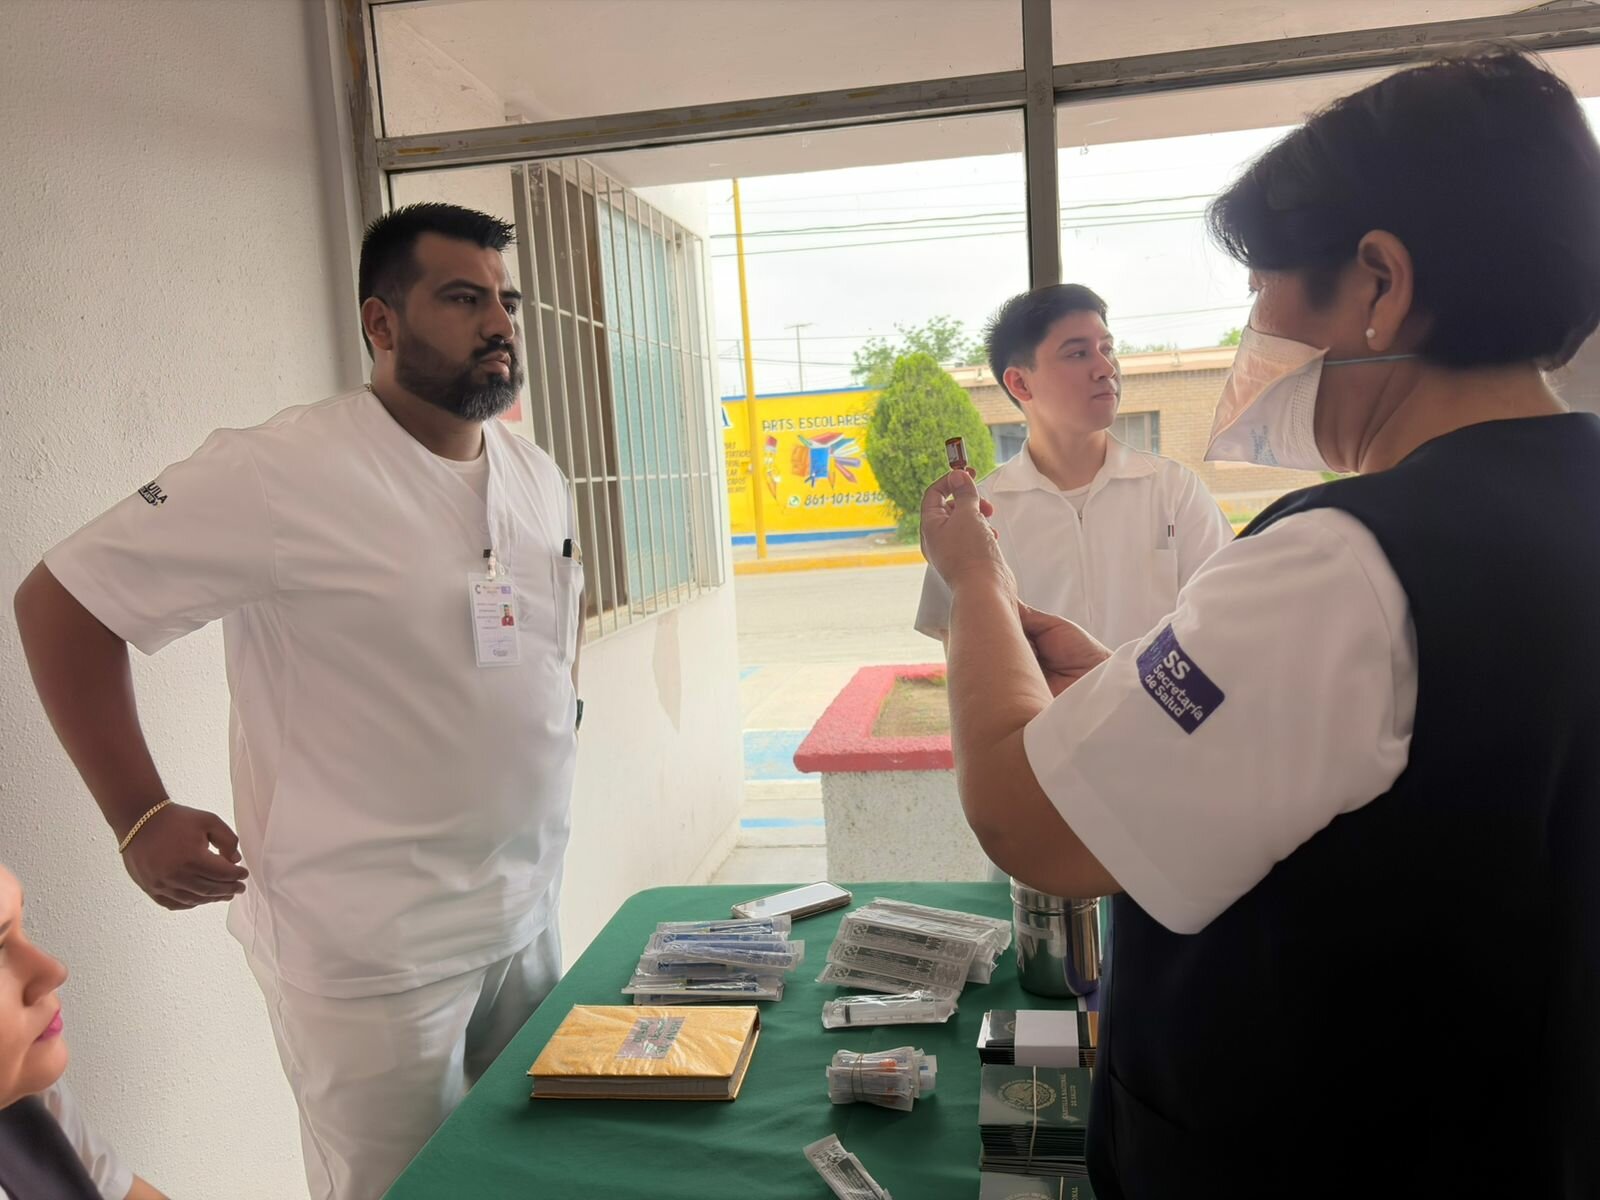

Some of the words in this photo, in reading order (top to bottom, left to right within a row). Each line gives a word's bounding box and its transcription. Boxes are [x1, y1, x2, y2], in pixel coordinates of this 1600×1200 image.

[799, 414, 868, 430] ESCOLARES
[147, 481, 168, 504] UILA
[1163, 650, 1191, 680] SS
[1145, 674, 1157, 689] de
[1154, 685, 1186, 718] Salud
[1153, 663, 1204, 720] Secretaría
